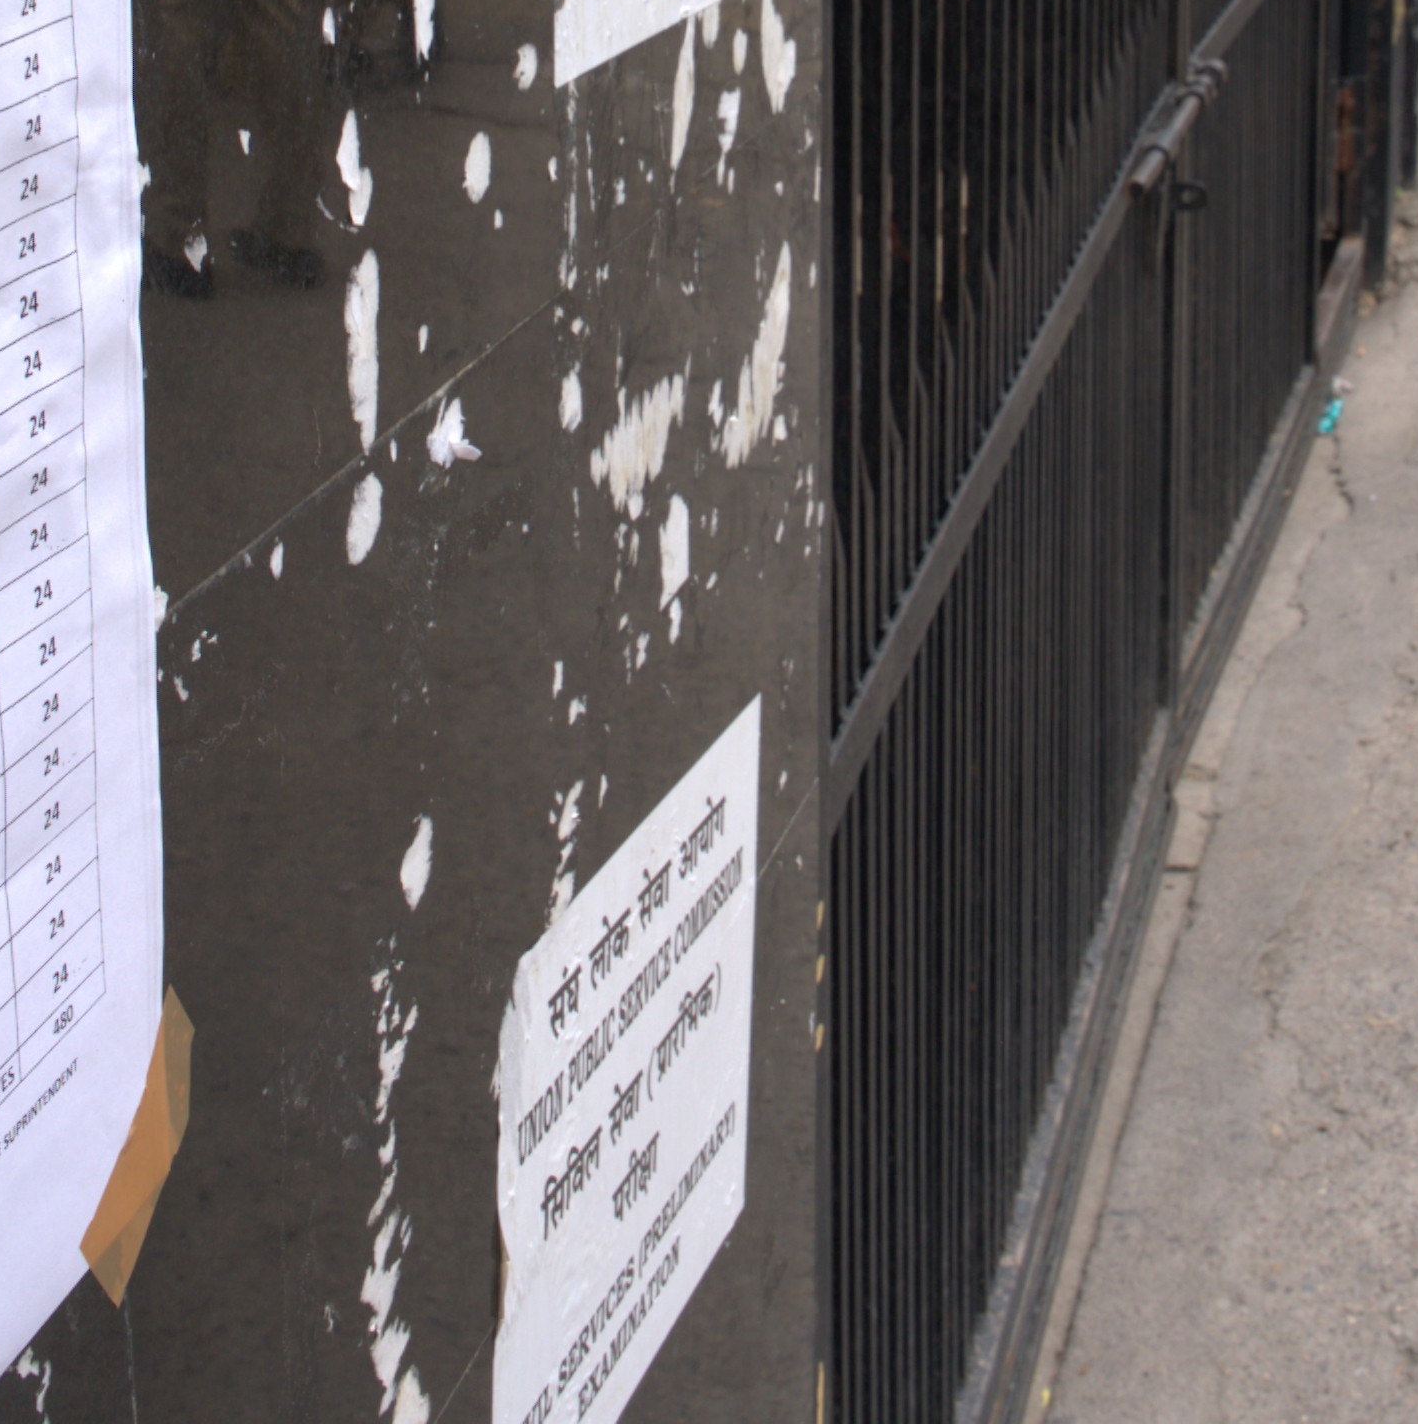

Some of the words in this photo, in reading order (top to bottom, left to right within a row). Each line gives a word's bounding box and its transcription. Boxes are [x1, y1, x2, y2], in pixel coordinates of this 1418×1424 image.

[24, 115, 41, 142] 24
[19, 232, 37, 260] 24
[23, 350, 42, 379] 24
[29, 467, 49, 496] 24
[34, 579, 53, 609] 24
[43, 693, 59, 722] 24
[44, 801, 60, 830] 24
[49, 909, 65, 940] 24
[548, 966, 582, 1039] संघ
[589, 915, 631, 990] लोक
[637, 859, 672, 931] सेवा
[678, 796, 726, 880] आयोग
[53, 963, 69, 994] 24
[53, 1004, 73, 1034] 480
[518, 1072, 564, 1166] UNION
[568, 1008, 615, 1092] PUBLIC
[618, 937, 672, 1038] SERVICE
[674, 846, 743, 965] COMMISSION
[540, 1125, 602, 1241] सिविल
[608, 1070, 641, 1145] सेवा
[612, 1131, 660, 1221] परीक्षा
[557, 1254, 636, 1396] SERVICES
[638, 1100, 736, 1279] (PRELIMINARY)
[578, 1235, 682, 1423] EXAMINATION
